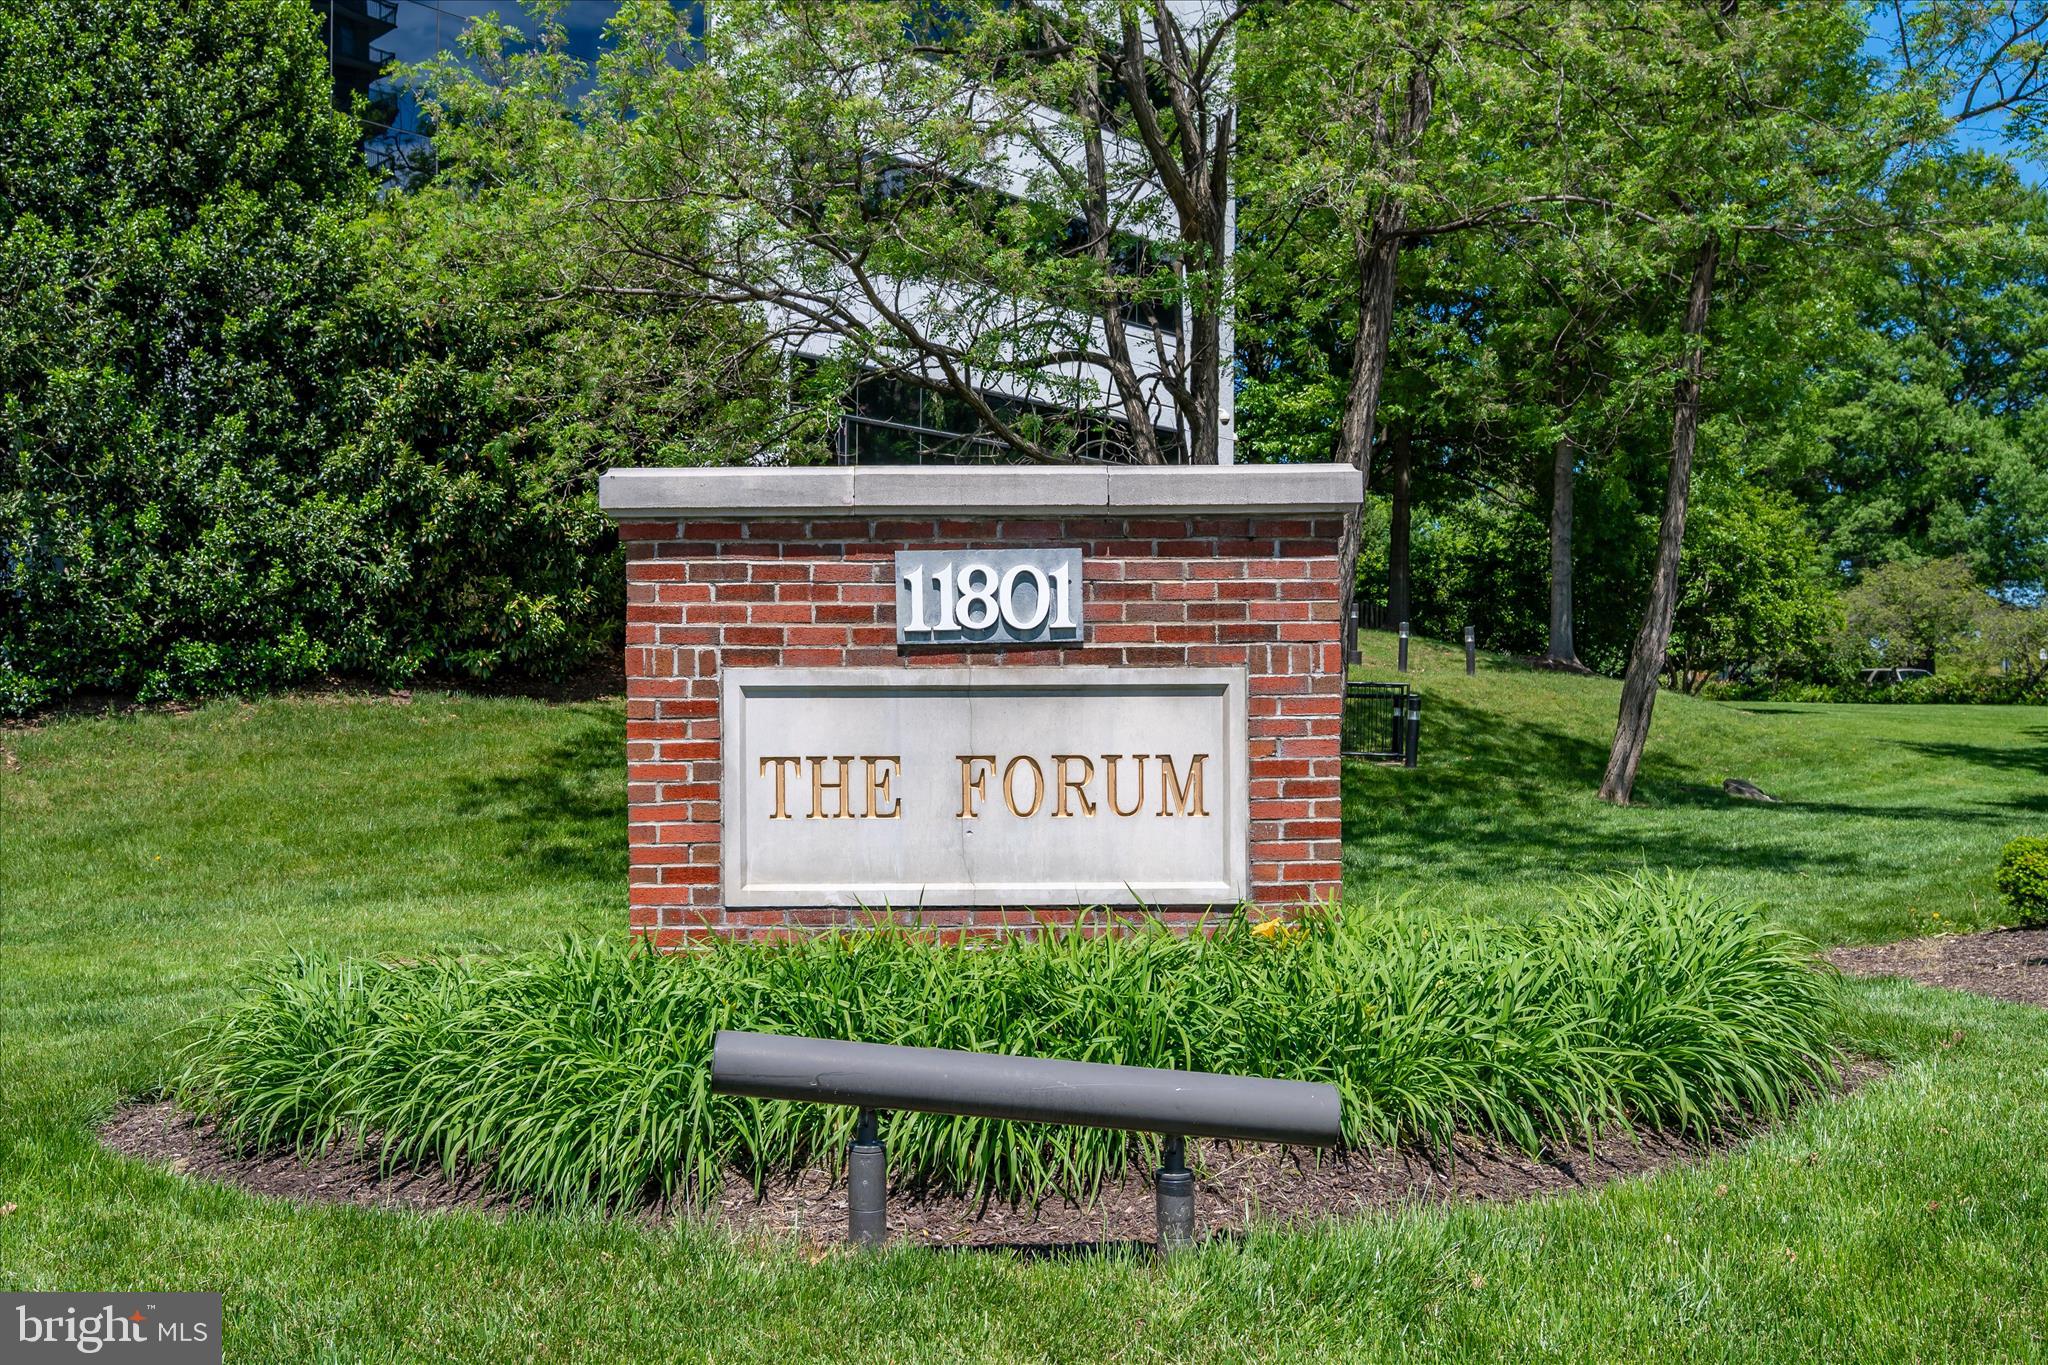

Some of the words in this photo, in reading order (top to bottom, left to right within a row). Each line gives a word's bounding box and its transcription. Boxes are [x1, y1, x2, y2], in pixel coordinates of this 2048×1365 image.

[903, 560, 1077, 632] 11801
[759, 755, 901, 819] THE
[955, 753, 1210, 818] FORUM
